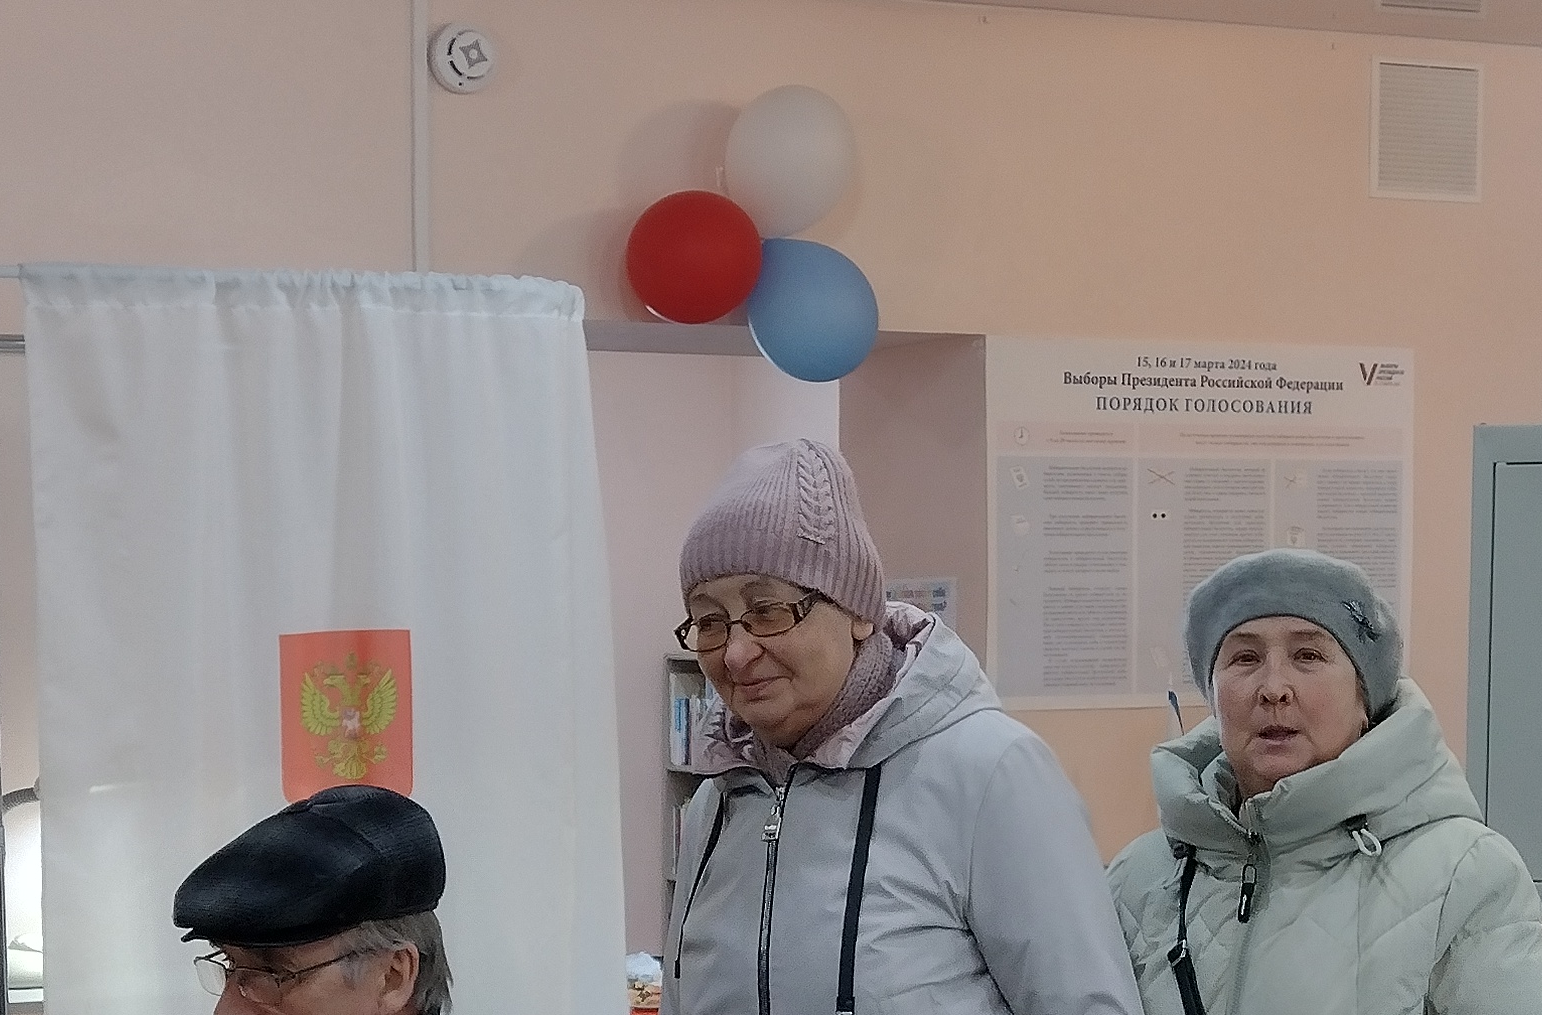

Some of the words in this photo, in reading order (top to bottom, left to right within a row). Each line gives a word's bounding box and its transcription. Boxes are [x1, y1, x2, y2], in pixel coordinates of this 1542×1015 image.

[1136, 356, 1152, 369] 15,
[1154, 356, 1167, 369] 16
[1168, 360, 1177, 369] и
[1180, 357, 1192, 369] 17
[1193, 360, 1226, 373] марта
[1228, 358, 1252, 370] 2024
[1254, 361, 1278, 372] года
[1062, 371, 1118, 390] Выборы
[1120, 373, 1198, 390] Президента
[1200, 374, 1273, 389] Российской
[1275, 376, 1344, 394] Федерации
[1095, 396, 1179, 414] ПОРЯДОК
[1184, 398, 1313, 415] ГОЛОСОВАНИЯ
